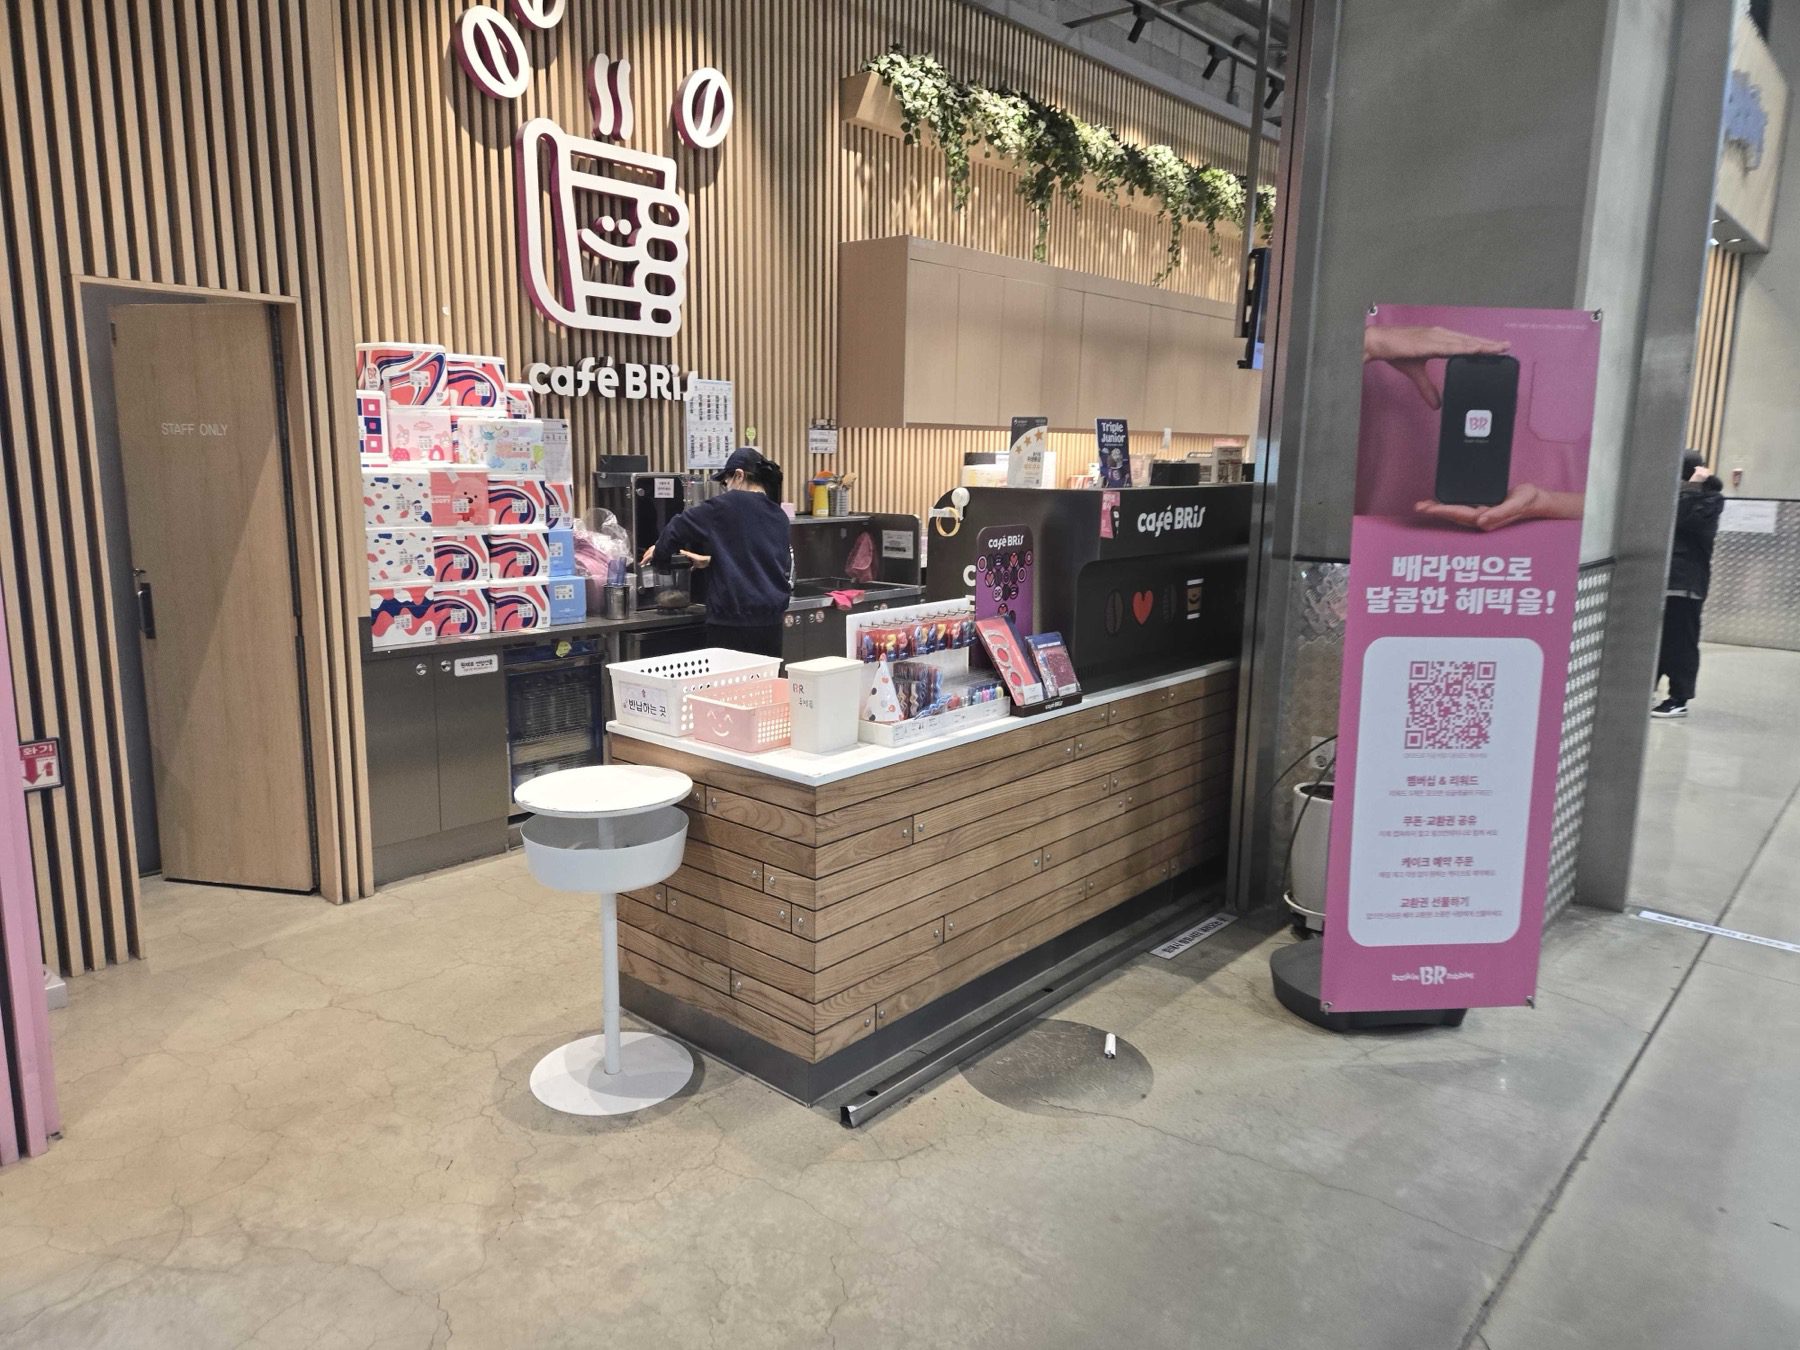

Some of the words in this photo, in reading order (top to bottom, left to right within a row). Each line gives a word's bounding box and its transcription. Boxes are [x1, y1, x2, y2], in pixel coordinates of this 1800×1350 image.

[528, 355, 620, 397] café
[160, 422, 195, 436] STAFF
[199, 422, 229, 436] ONLY
[1101, 421, 1124, 433] Triple
[1469, 416, 1489, 430] BR
[1101, 432, 1126, 443] Junior
[1137, 504, 1173, 537] café
[988, 534, 1007, 550] café
[1391, 554, 1533, 582] 배라앱으로
[1365, 586, 1449, 614] 달콤한
[1455, 587, 1557, 616] 혜택을!
[659, 705, 667, 718] 곳
[23, 744, 53, 756] 화기
[1439, 776, 1447, 786] &
[1449, 775, 1480, 786] 리워드
[1458, 815, 1478, 827] 공유
[1401, 857, 1431, 868] 케이크
[1432, 856, 1452, 868] 예약
[1454, 855, 1475, 867] 주문
[1400, 897, 1429, 908] 교환권
[1431, 896, 1470, 908] 선물하기
[1419, 965, 1447, 986] BR
